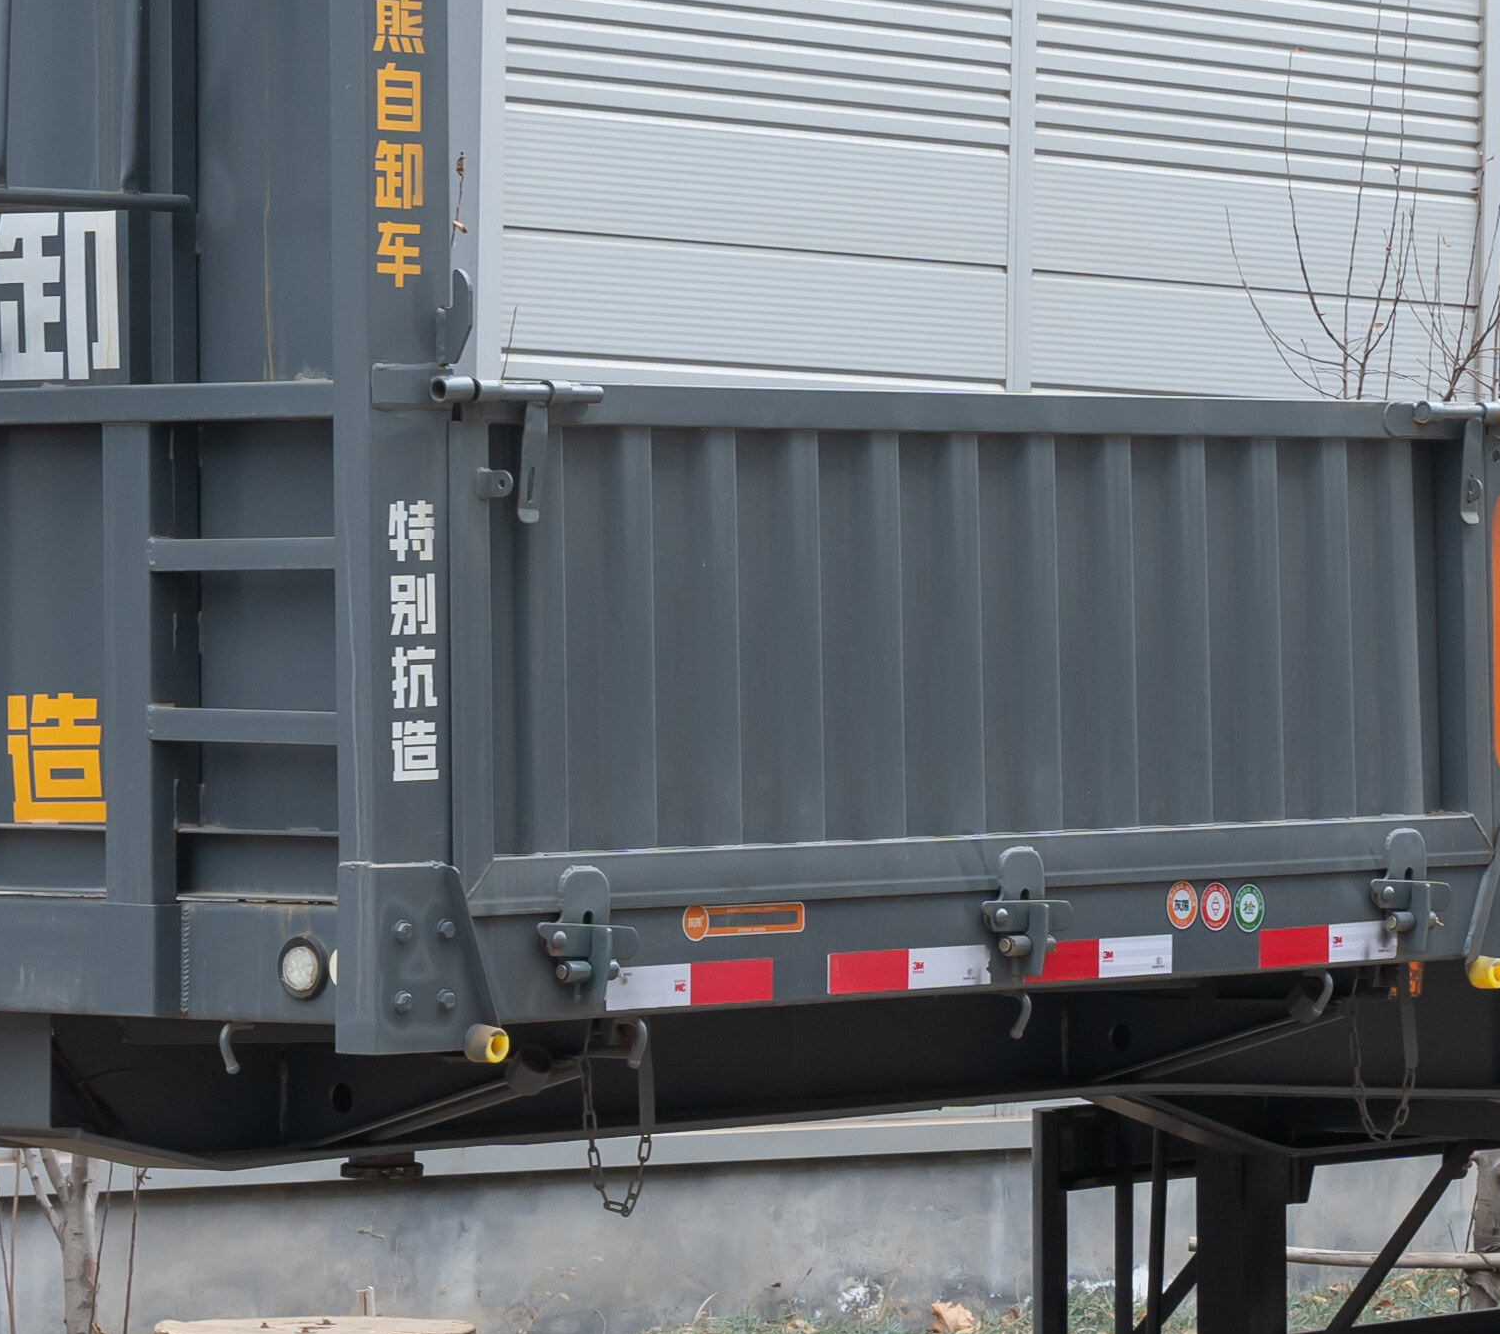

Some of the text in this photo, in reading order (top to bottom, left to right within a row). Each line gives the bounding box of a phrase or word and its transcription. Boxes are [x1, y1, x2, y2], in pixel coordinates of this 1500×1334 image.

[388, 499, 439, 782] 特别抗造
[1102, 950, 1115, 959] 3M
[912, 961, 925, 971] 3M
